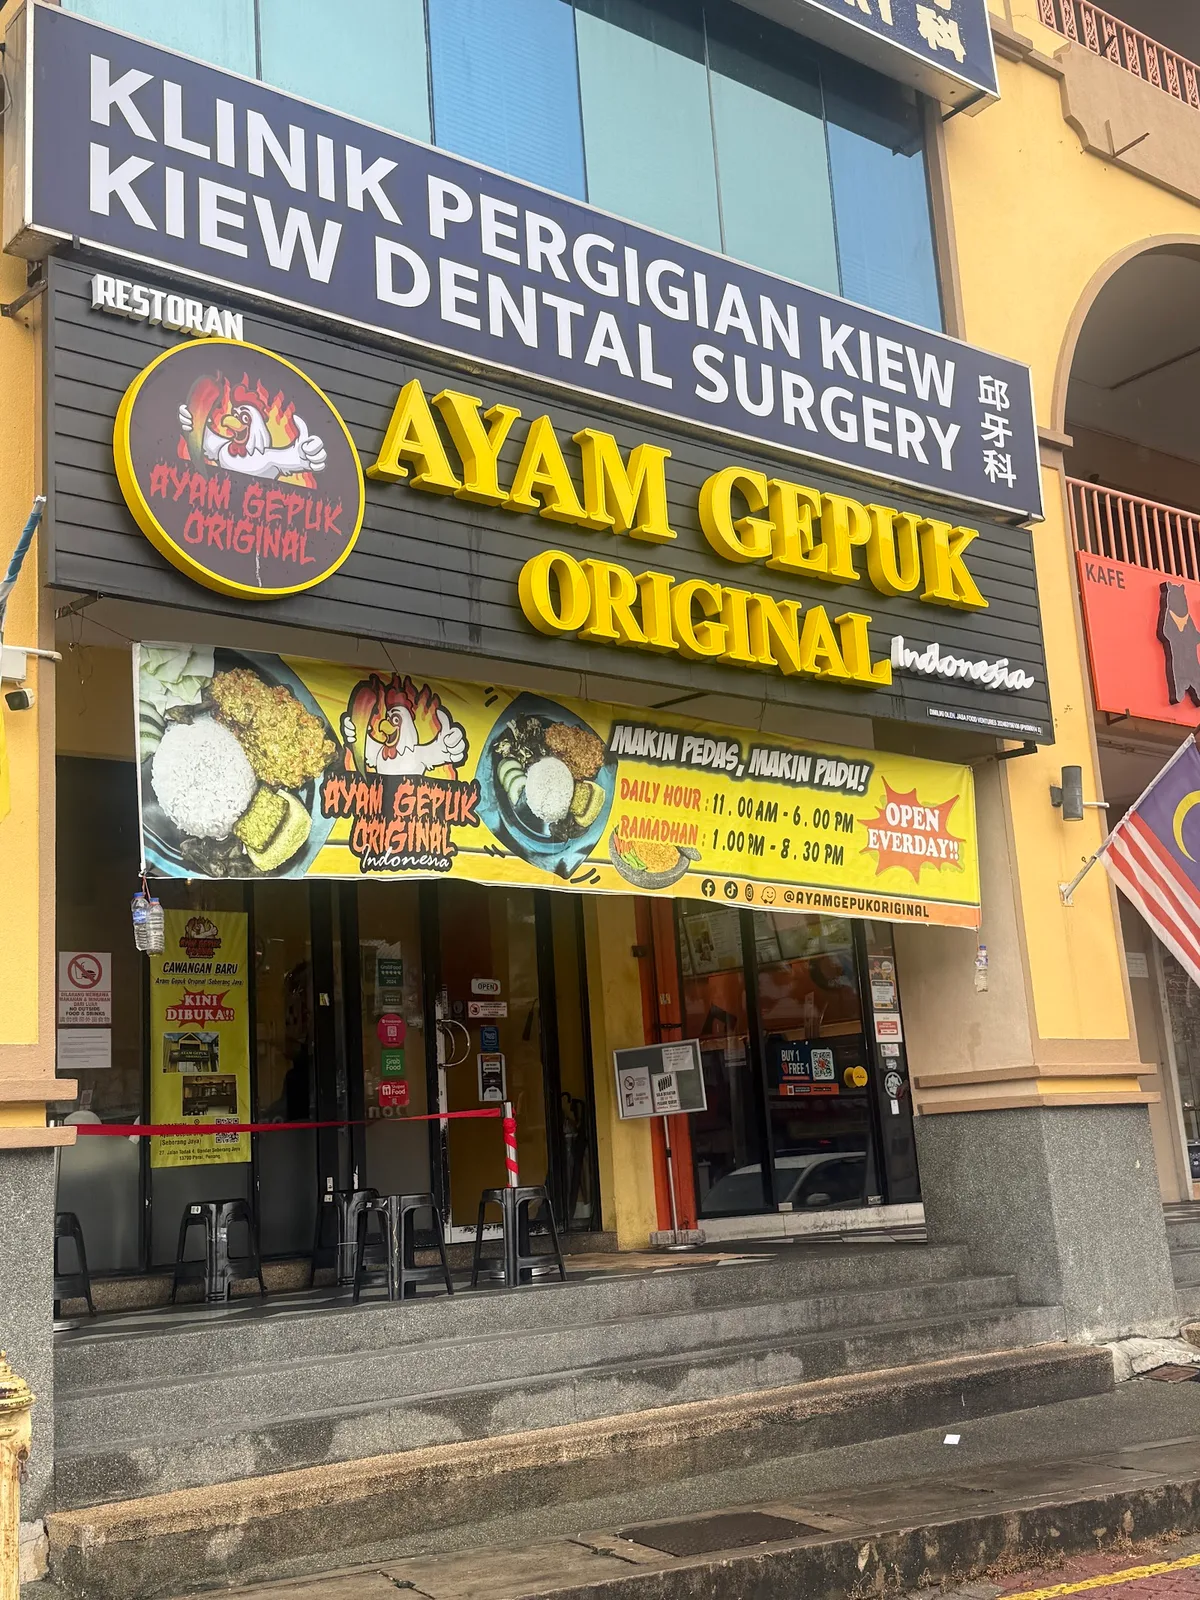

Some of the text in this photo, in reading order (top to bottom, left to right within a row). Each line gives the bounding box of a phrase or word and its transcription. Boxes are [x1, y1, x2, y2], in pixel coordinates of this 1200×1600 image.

[90, 54, 956, 409] KLINIK PERGIGIAN KIEW
[89, 142, 962, 472] KIEW DENTAL SURGERY
[91, 273, 245, 341] RESTORAN
[977, 374, 1017, 489] 邱牙科
[150, 460, 343, 536] AYAM GEPUK
[366, 378, 990, 612] AYAM GEPUK
[183, 506, 317, 566] ORIGINAL
[1085, 562, 1126, 590] KAFE
[518, 549, 893, 690] ORIGINAL
[890, 635, 1035, 691] Indonesia
[610, 725, 870, 792] MAKIN PEDAS, MAKIN PADU!
[324, 774, 478, 823] AYAM GEPUK
[620, 778, 661, 805] DAILY
[663, 784, 702, 812] HOUR
[352, 813, 456, 856] ORIGINAL
[885, 802, 940, 832] OPEN
[361, 844, 450, 869] Indonesia
[620, 815, 699, 846] RAMADHAN
[824, 843, 844, 866] PM
[867, 828, 959, 860] EVERDAY!!
[783, 890, 930, 918] @AYAMGEPUKORIGINAL
[163, 962, 238, 975] CAWANGAN BARU
[477, 982, 495, 991] OPEN
[166, 1009, 234, 1020] DIBUKA!!
[184, 995, 218, 1006] KINI
[781, 1049, 800, 1061] BUY 1
[788, 1062, 810, 1074] FREE 1
